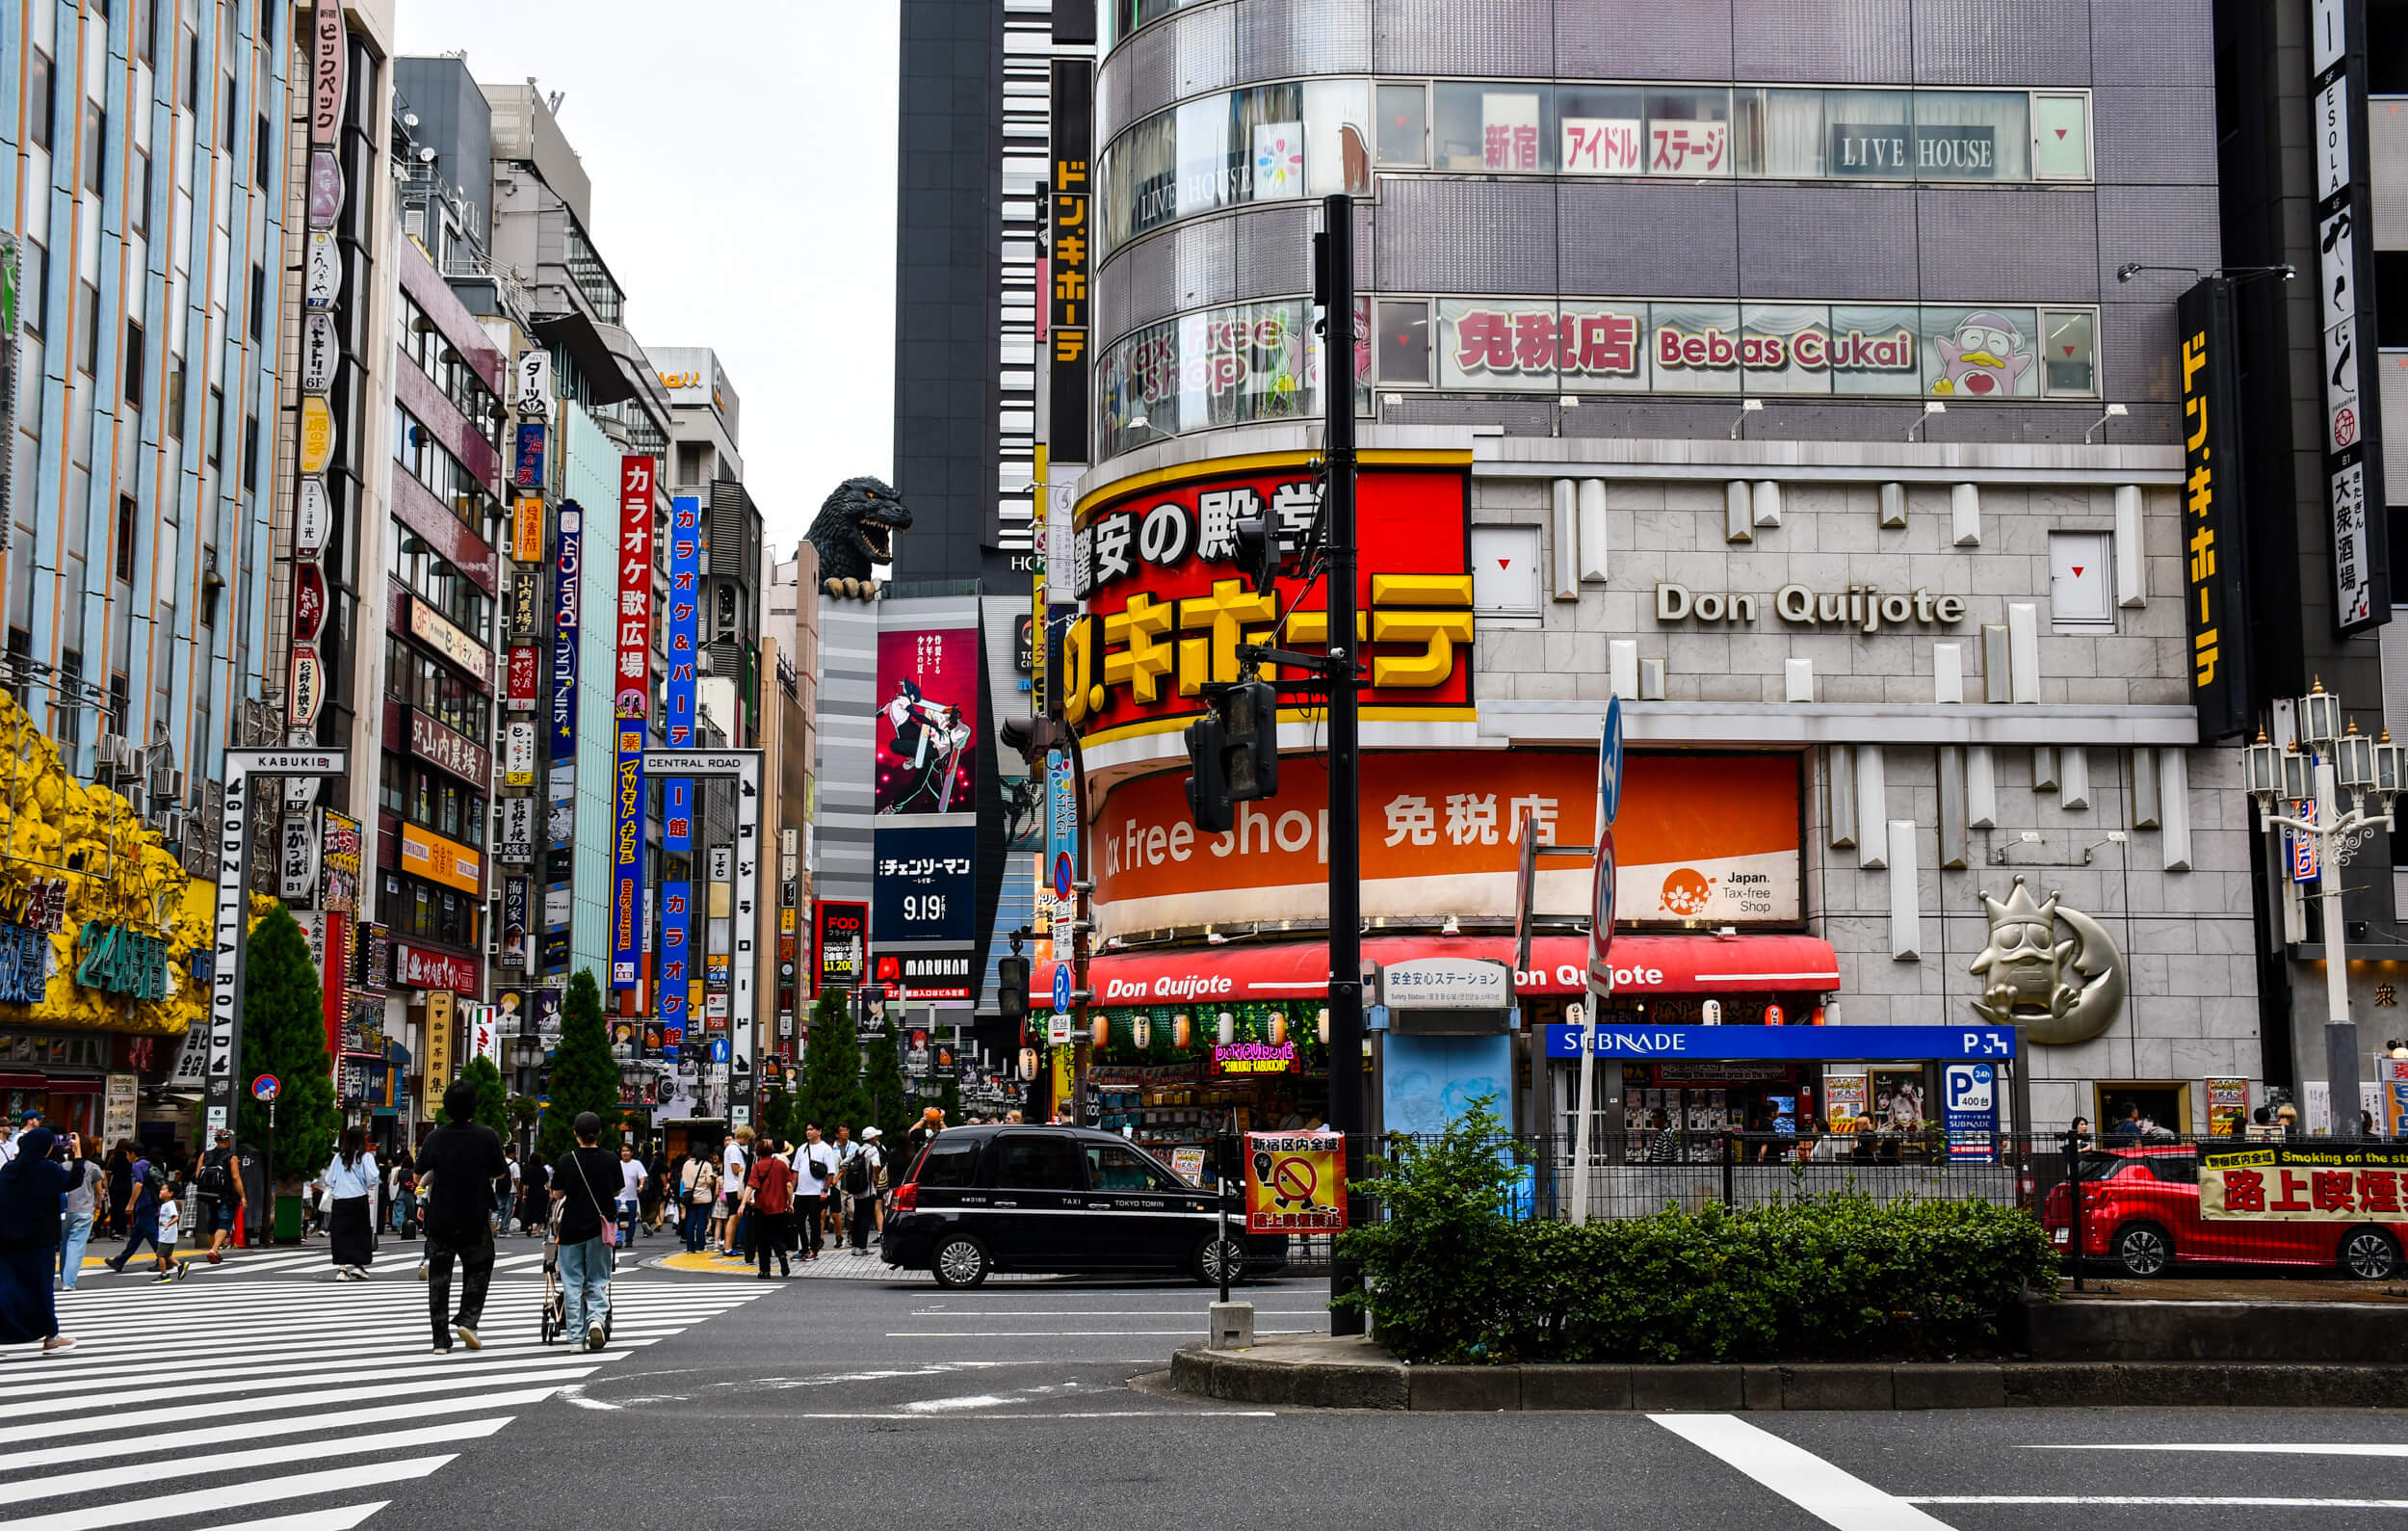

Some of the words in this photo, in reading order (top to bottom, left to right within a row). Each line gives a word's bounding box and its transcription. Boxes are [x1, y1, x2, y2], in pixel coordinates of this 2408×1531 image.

[1485, 123, 1538, 171] 新宿
[1565, 127, 1638, 170] アイドル
[1652, 127, 1725, 172] ステージ
[1842, 138, 1905, 167] LIVE
[1918, 139, 1993, 169] HOUSE
[2325, 88, 2340, 193] ESOLA
[1140, 181, 1177, 222] LIVE
[1188, 165, 1252, 204] HOUSE
[1454, 308, 1640, 374] 免税店
[1656, 326, 1787, 373] Bebas
[1792, 327, 1916, 371] Cukai
[305, 377, 326, 388] 6F
[525, 361, 541, 402] ダーツ
[302, 462, 318, 471] 4F
[2335, 477, 2356, 592] 大衆酒場
[619, 466, 649, 679] カラオケ歌広場
[515, 574, 535, 625] 山内農場
[1656, 582, 1757, 622] Don
[1776, 583, 1967, 634] Quijote
[554, 642, 574, 723] SHINJUKU
[515, 700, 529, 710] 4F
[423, 721, 477, 780] 山内農場
[620, 732, 642, 752] 薬
[512, 773, 527, 783] 3F
[648, 758, 705, 769] CENTRAL
[708, 758, 741, 768] ROAD
[619, 759, 641, 864] マツモトキヨシ
[1056, 793, 1067, 839] STAGE
[1383, 793, 1558, 848] 免税店
[285, 833, 305, 878] かっぱ
[1125, 818, 1195, 871] Free
[218, 800, 243, 955] GODZILLA
[884, 858, 971, 876] チェンソーマン
[1727, 871, 1770, 885] Japan.
[286, 883, 301, 891] B1
[507, 880, 524, 920] 海の家
[1722, 886, 1771, 899] Tax-free
[828, 917, 859, 930] FOD
[903, 895, 941, 920] 9.19
[1740, 900, 1771, 914] Shop
[311, 913, 325, 966] 大衆酒場
[738, 823, 756, 1030] ゴジラロード
[663, 896, 686, 1047] カラオケ館
[904, 958, 969, 976] MARUHAN
[1390, 971, 1500, 986] 安全安心ステーション
[1556, 964, 1663, 990] Qjote
[1107, 978, 1147, 998] Don
[1154, 973, 1233, 997] Quijote
[2373, 983, 2398, 1007] 衆
[213, 973, 234, 1048] ROAD
[1963, 1033, 1979, 1054] P
[1950, 1072, 1973, 1107] P
[1251, 1137, 1339, 1152] 新宿区内全域
[2208, 1152, 2274, 1168] 新宿区内全域
[2282, 1151, 2342, 1165] Smoking
[2344, 1154, 2363, 1163] on
[2365, 1152, 2389, 1163] the
